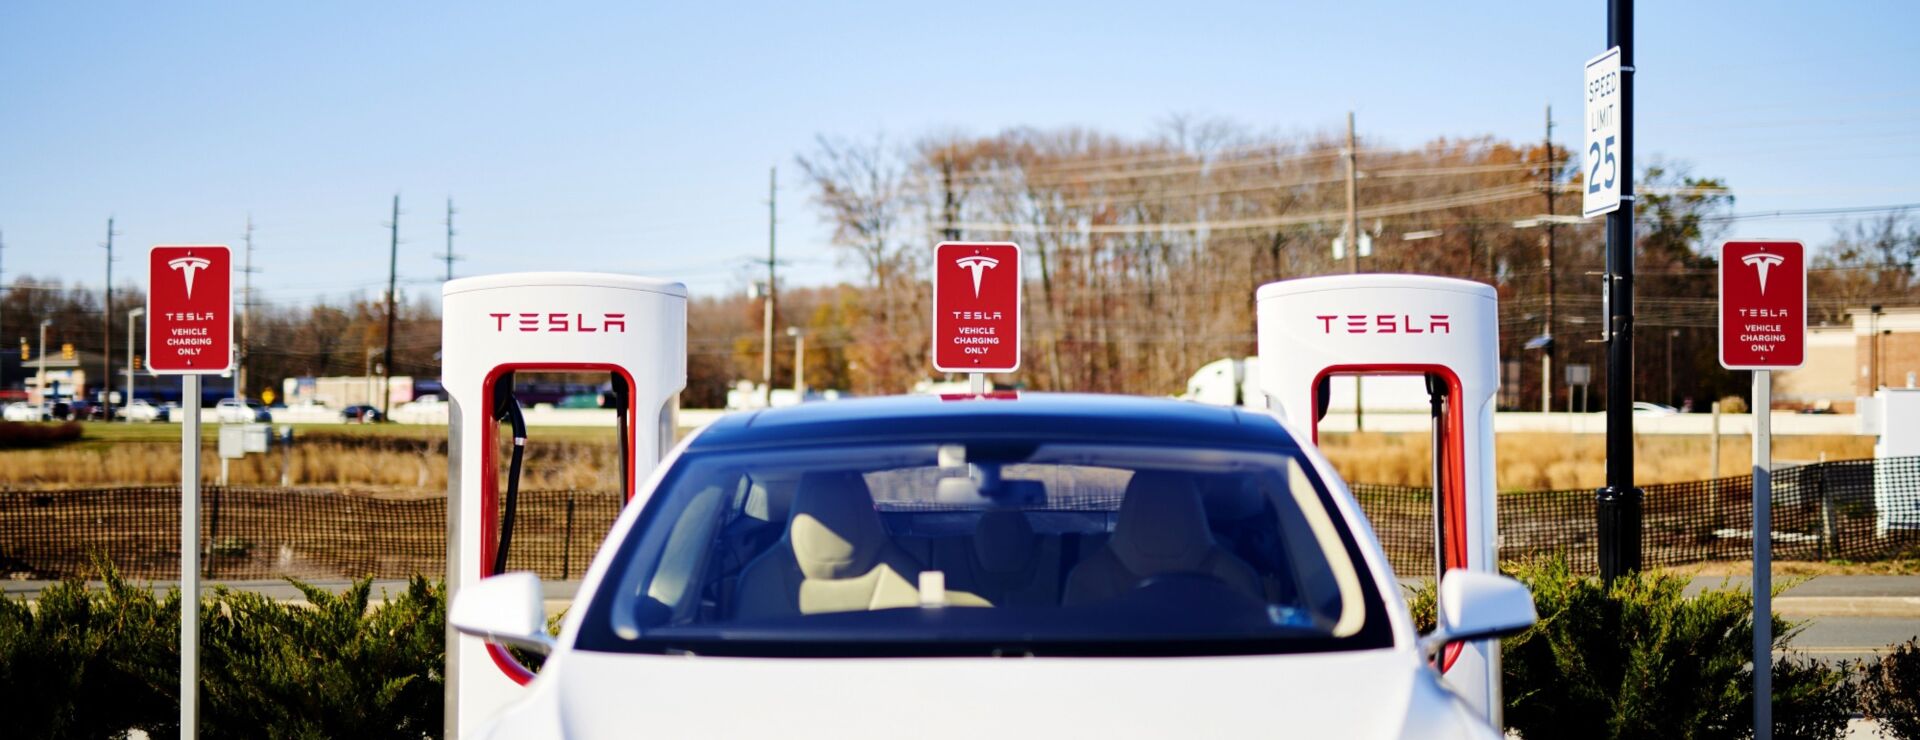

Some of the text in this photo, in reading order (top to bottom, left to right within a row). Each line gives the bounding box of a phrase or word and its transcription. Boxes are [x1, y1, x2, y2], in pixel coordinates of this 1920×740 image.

[1588, 71, 1617, 103] SPEED
[1591, 104, 1614, 132] LIMIT
[1588, 136, 1616, 194] 25
[165, 312, 214, 321] TESLA
[952, 311, 1002, 320] TESLA
[1739, 308, 1788, 317] TESLA
[489, 312, 626, 333] TESLA
[1316, 314, 1451, 334] TESLA
[171, 327, 208, 336] VEHICLE
[958, 326, 995, 335] VEHICLE
[1744, 324, 1781, 332] VEHICLE
[166, 337, 212, 346] CHARGING
[953, 336, 1000, 345] CHARGING
[1740, 334, 1786, 342] CHARGING
[177, 347, 202, 356] ONLY
[964, 346, 989, 355] ONLY
[1751, 344, 1775, 352] ONLY
